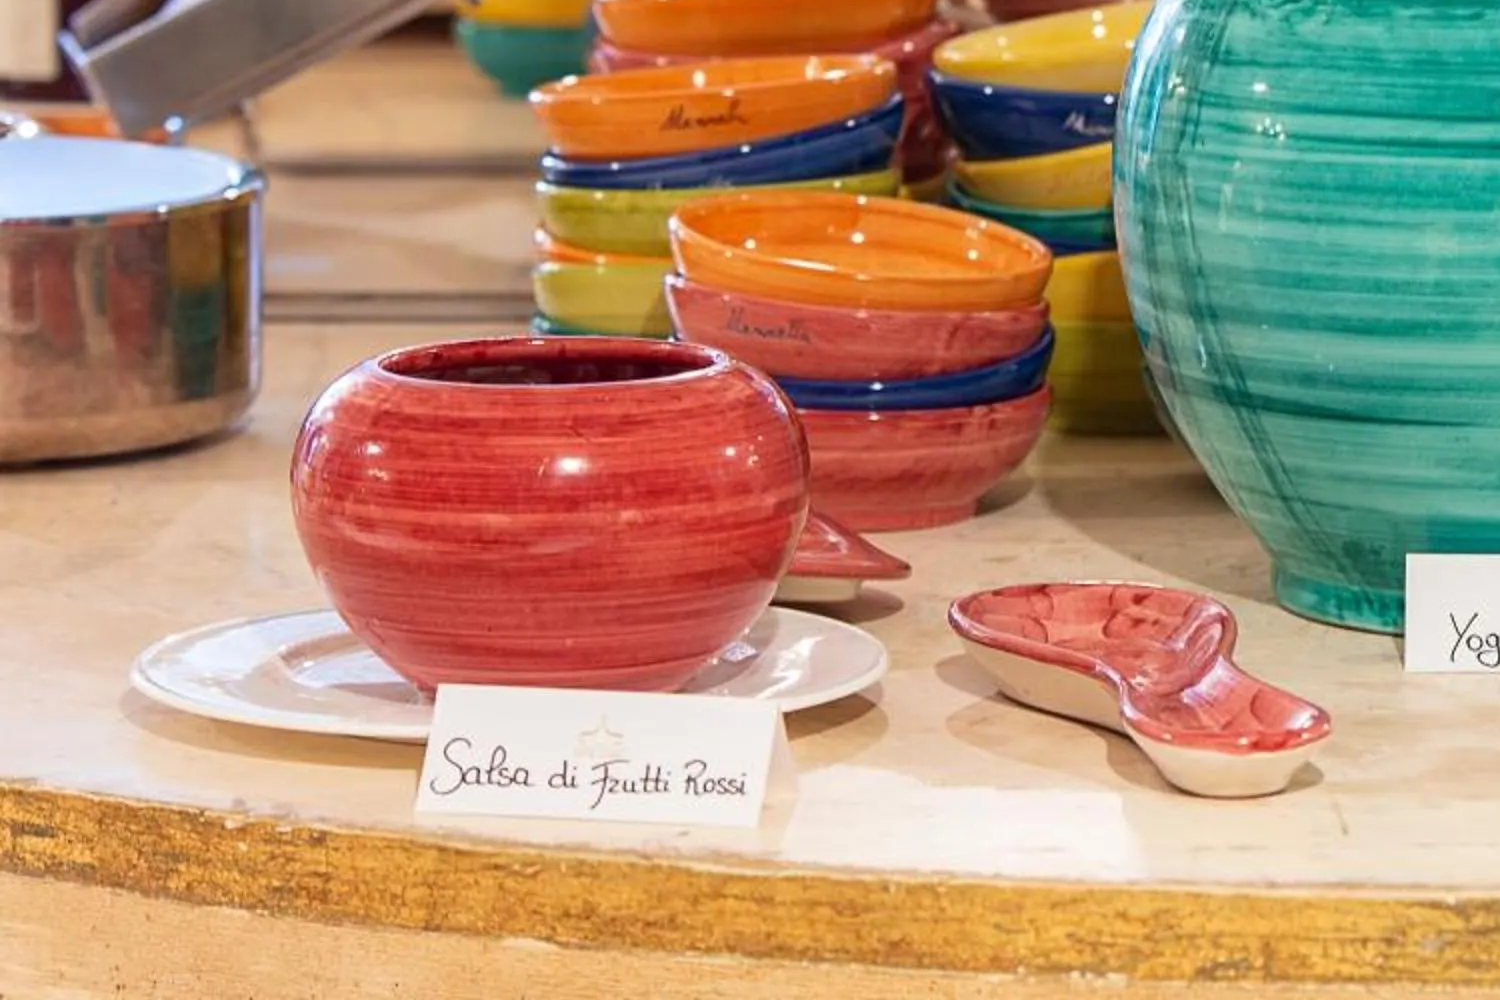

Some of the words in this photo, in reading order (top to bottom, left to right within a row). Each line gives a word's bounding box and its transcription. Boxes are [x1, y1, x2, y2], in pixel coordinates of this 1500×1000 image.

[429, 737, 534, 797] Salsa
[546, 760, 580, 791] di
[590, 759, 673, 811] Frutti
[682, 759, 748, 796] Rossi
